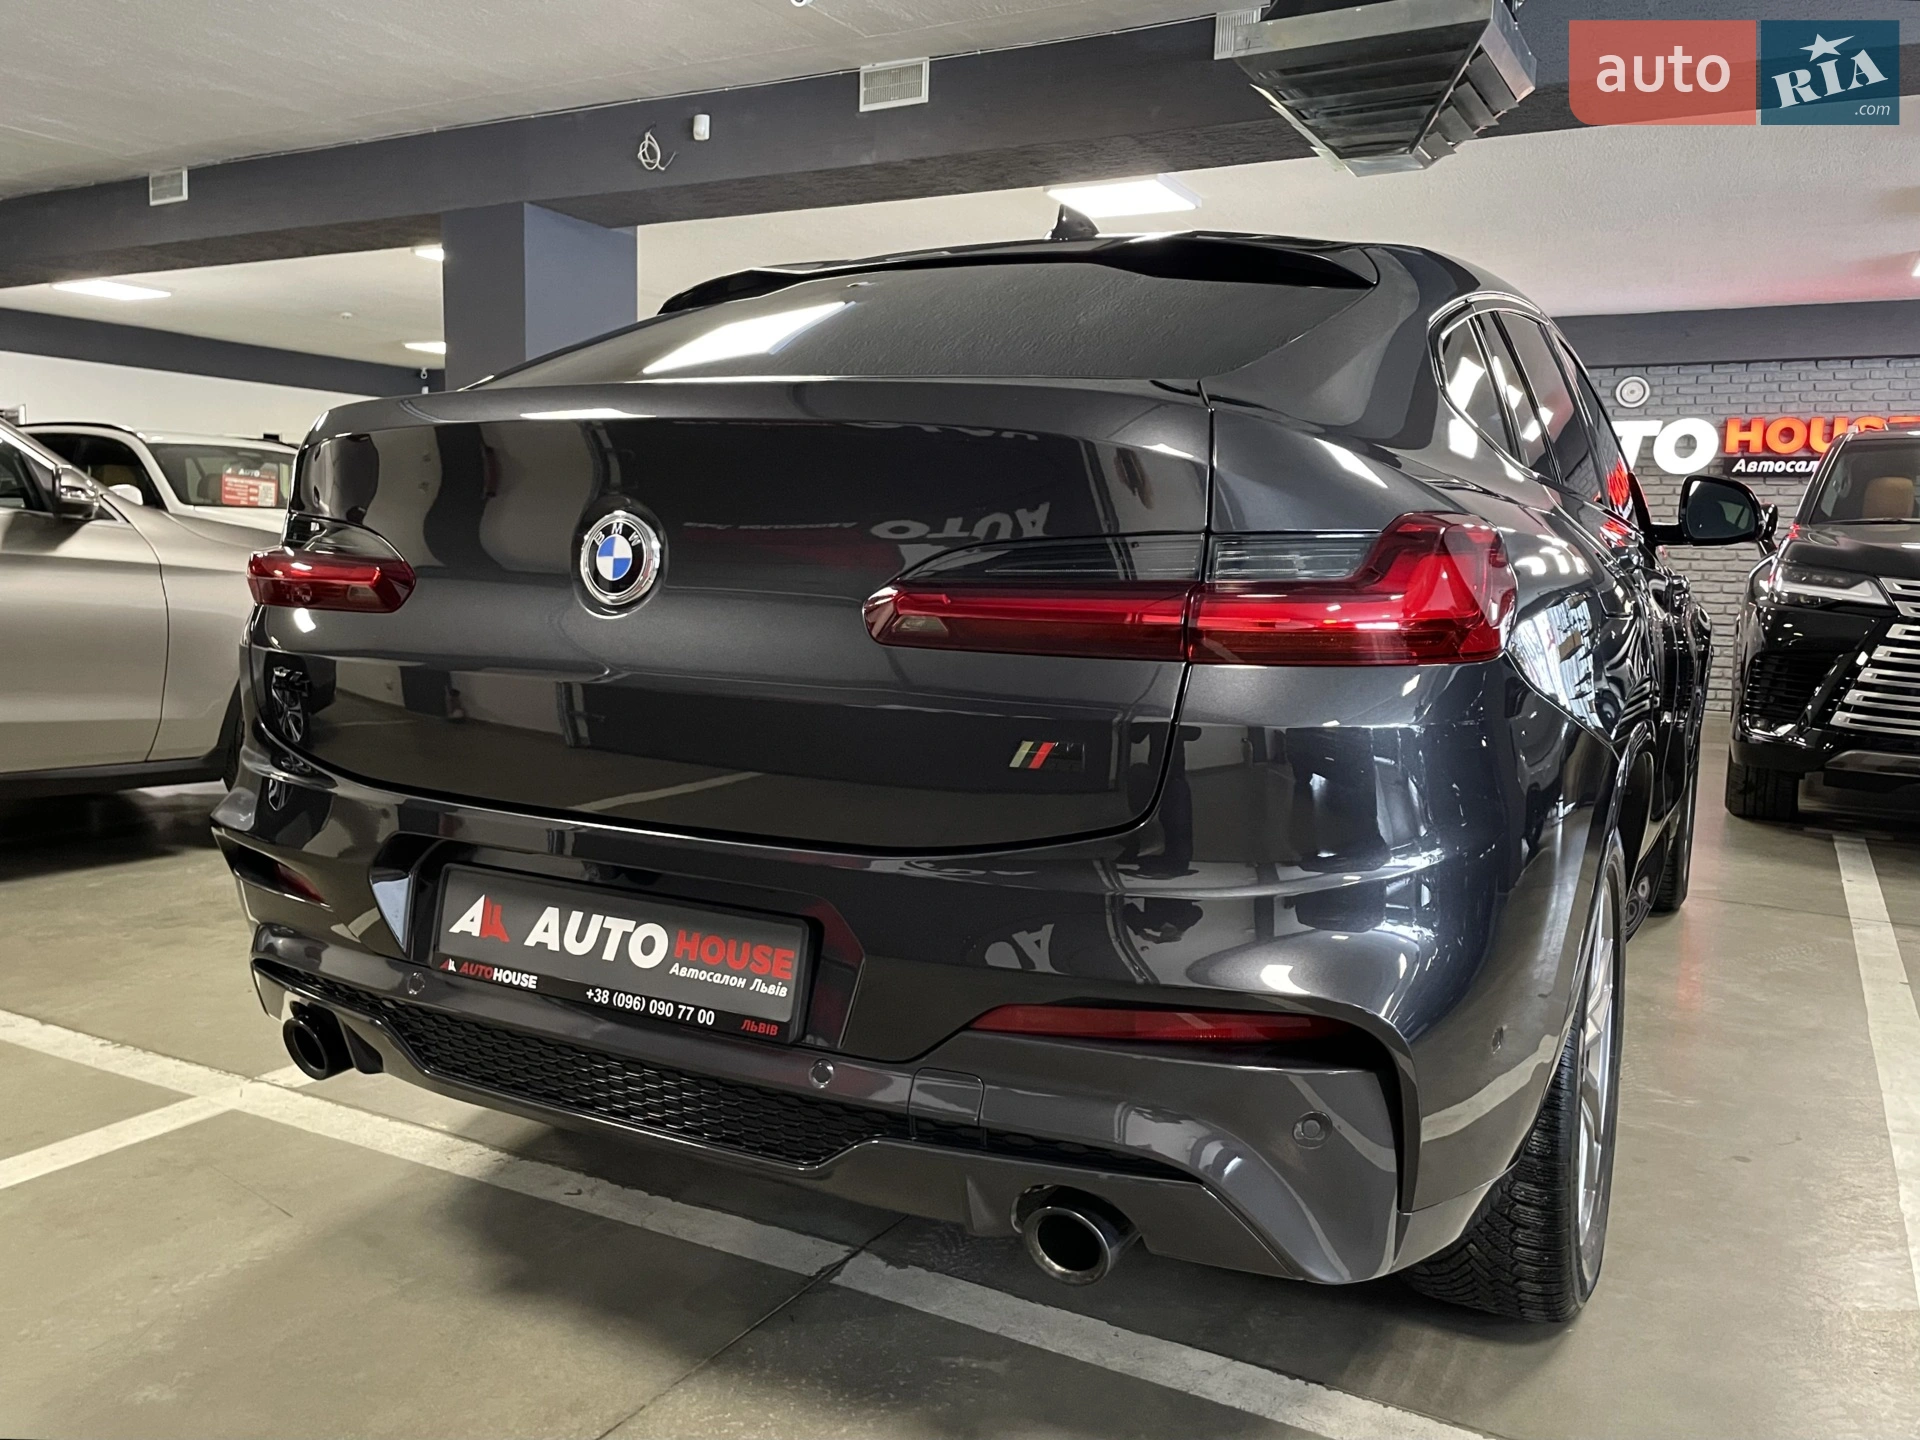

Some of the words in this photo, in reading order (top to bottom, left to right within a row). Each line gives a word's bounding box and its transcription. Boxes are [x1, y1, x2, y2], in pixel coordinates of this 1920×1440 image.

[593, 521, 641, 547] BMW
[523, 906, 669, 969] AUTO
[674, 929, 796, 980] HOUSE
[669, 962, 747, 989] Автосалон
[749, 978, 789, 998] Львів
[585, 987, 610, 1005] +38
[612, 991, 647, 1013] (096)
[649, 999, 675, 1018] 090
[678, 1004, 696, 1022] 77
[697, 1008, 716, 1027] 00
